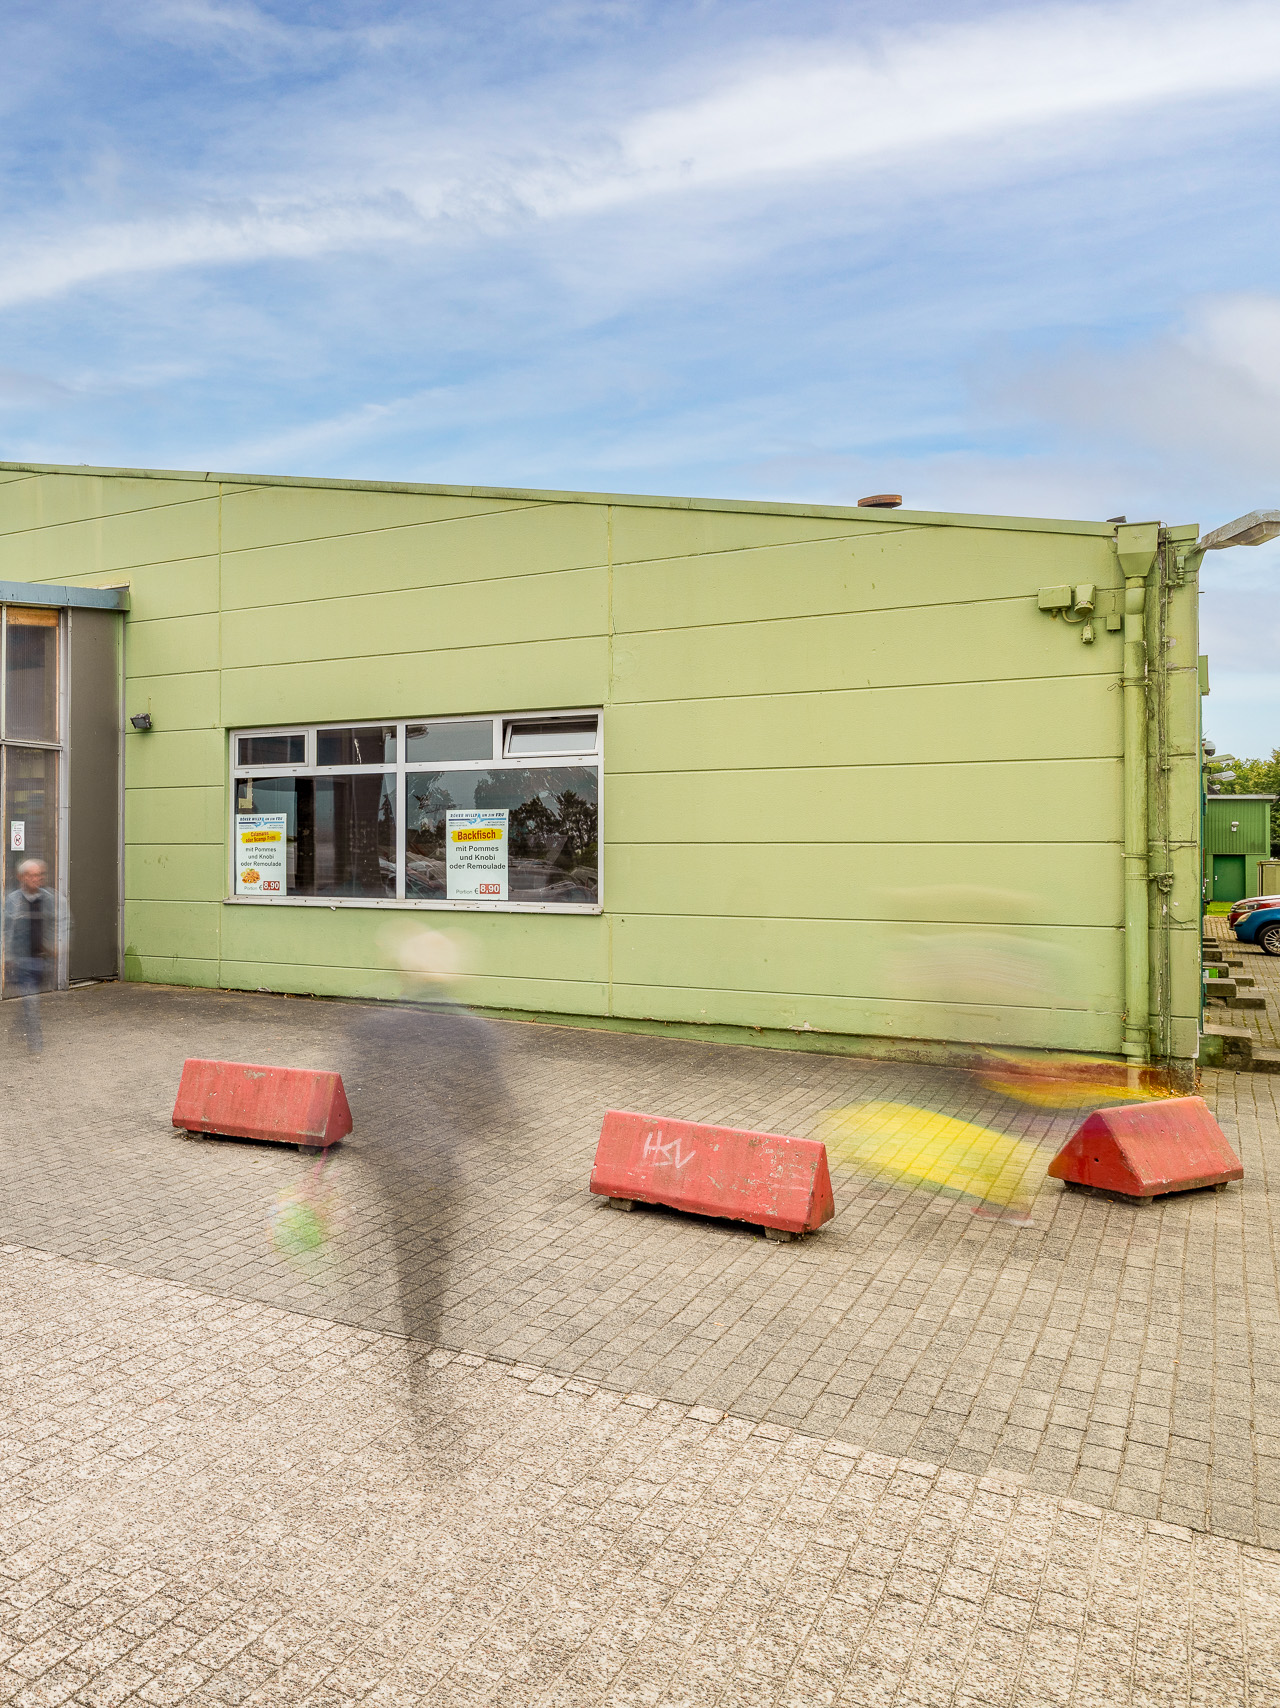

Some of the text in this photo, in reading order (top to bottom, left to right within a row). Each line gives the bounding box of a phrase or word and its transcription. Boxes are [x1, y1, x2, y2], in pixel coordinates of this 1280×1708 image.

[457, 830, 496, 840] Backfisch
[263, 881, 280, 890] 8,90
[480, 885, 500, 894] 8,90
